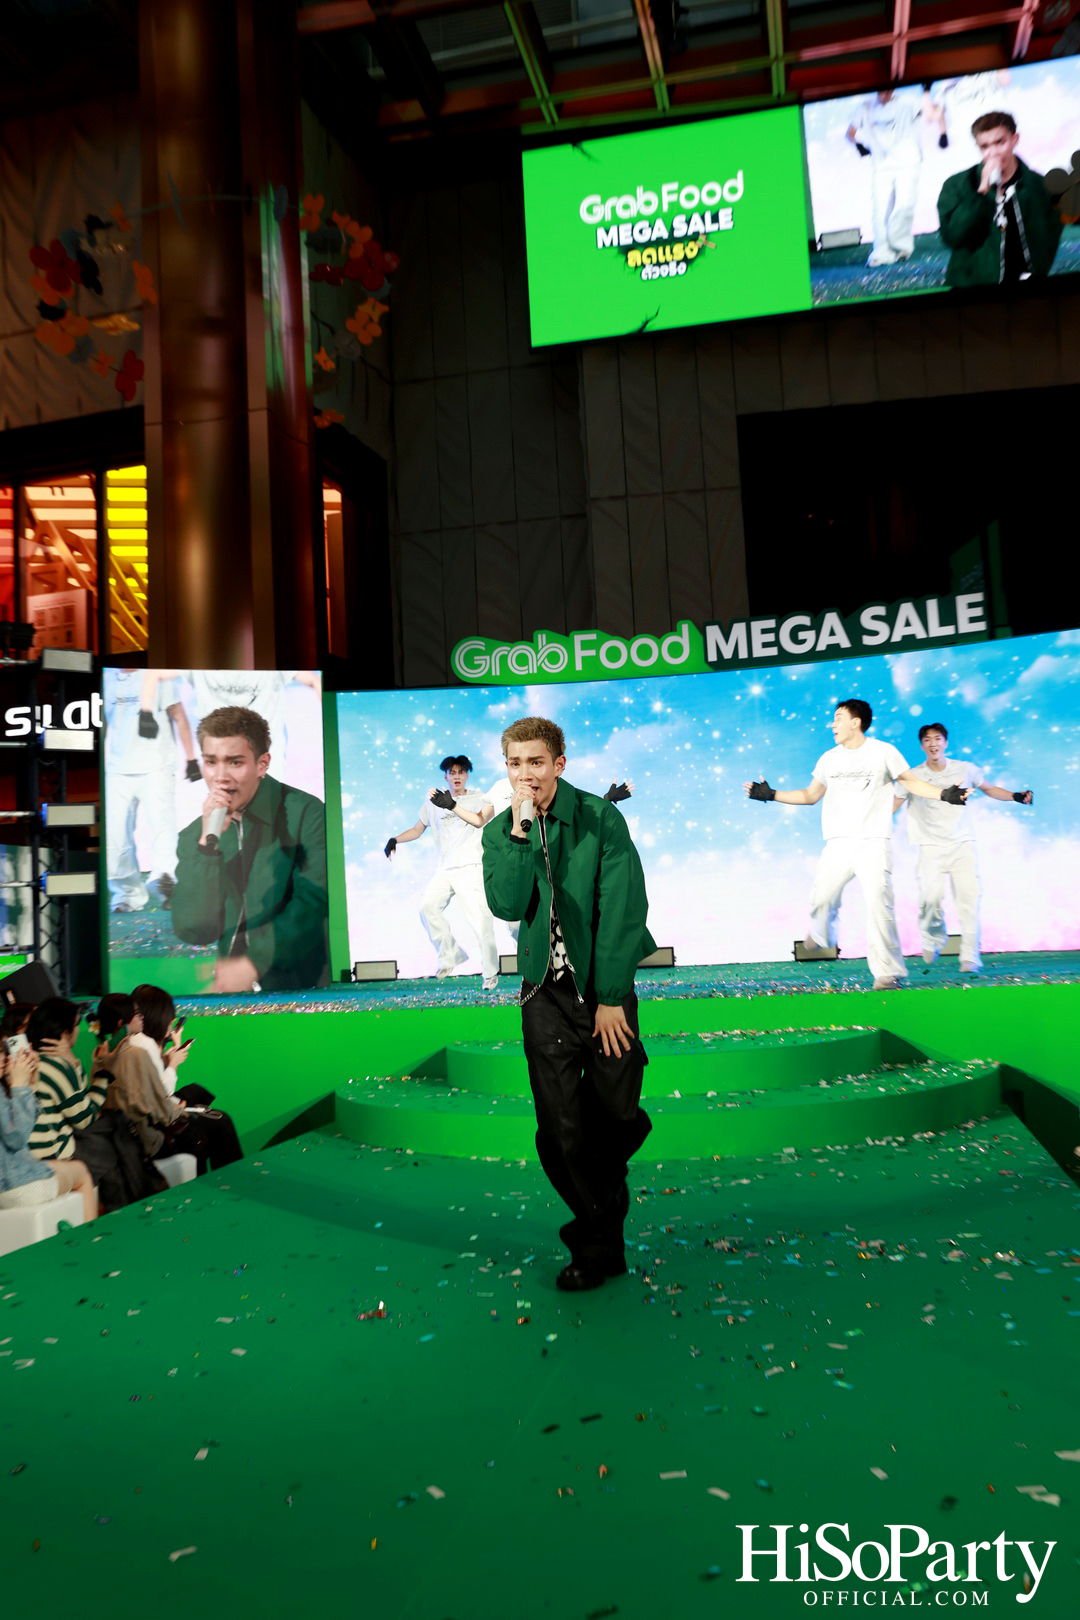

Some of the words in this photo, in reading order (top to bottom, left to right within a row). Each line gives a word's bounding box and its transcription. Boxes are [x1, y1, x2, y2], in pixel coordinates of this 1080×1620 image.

[580, 169, 744, 225] GrabFood
[596, 218, 669, 249] MEGA
[673, 207, 734, 238] SALE
[706, 613, 851, 662] MEGA
[860, 592, 987, 646] SALE
